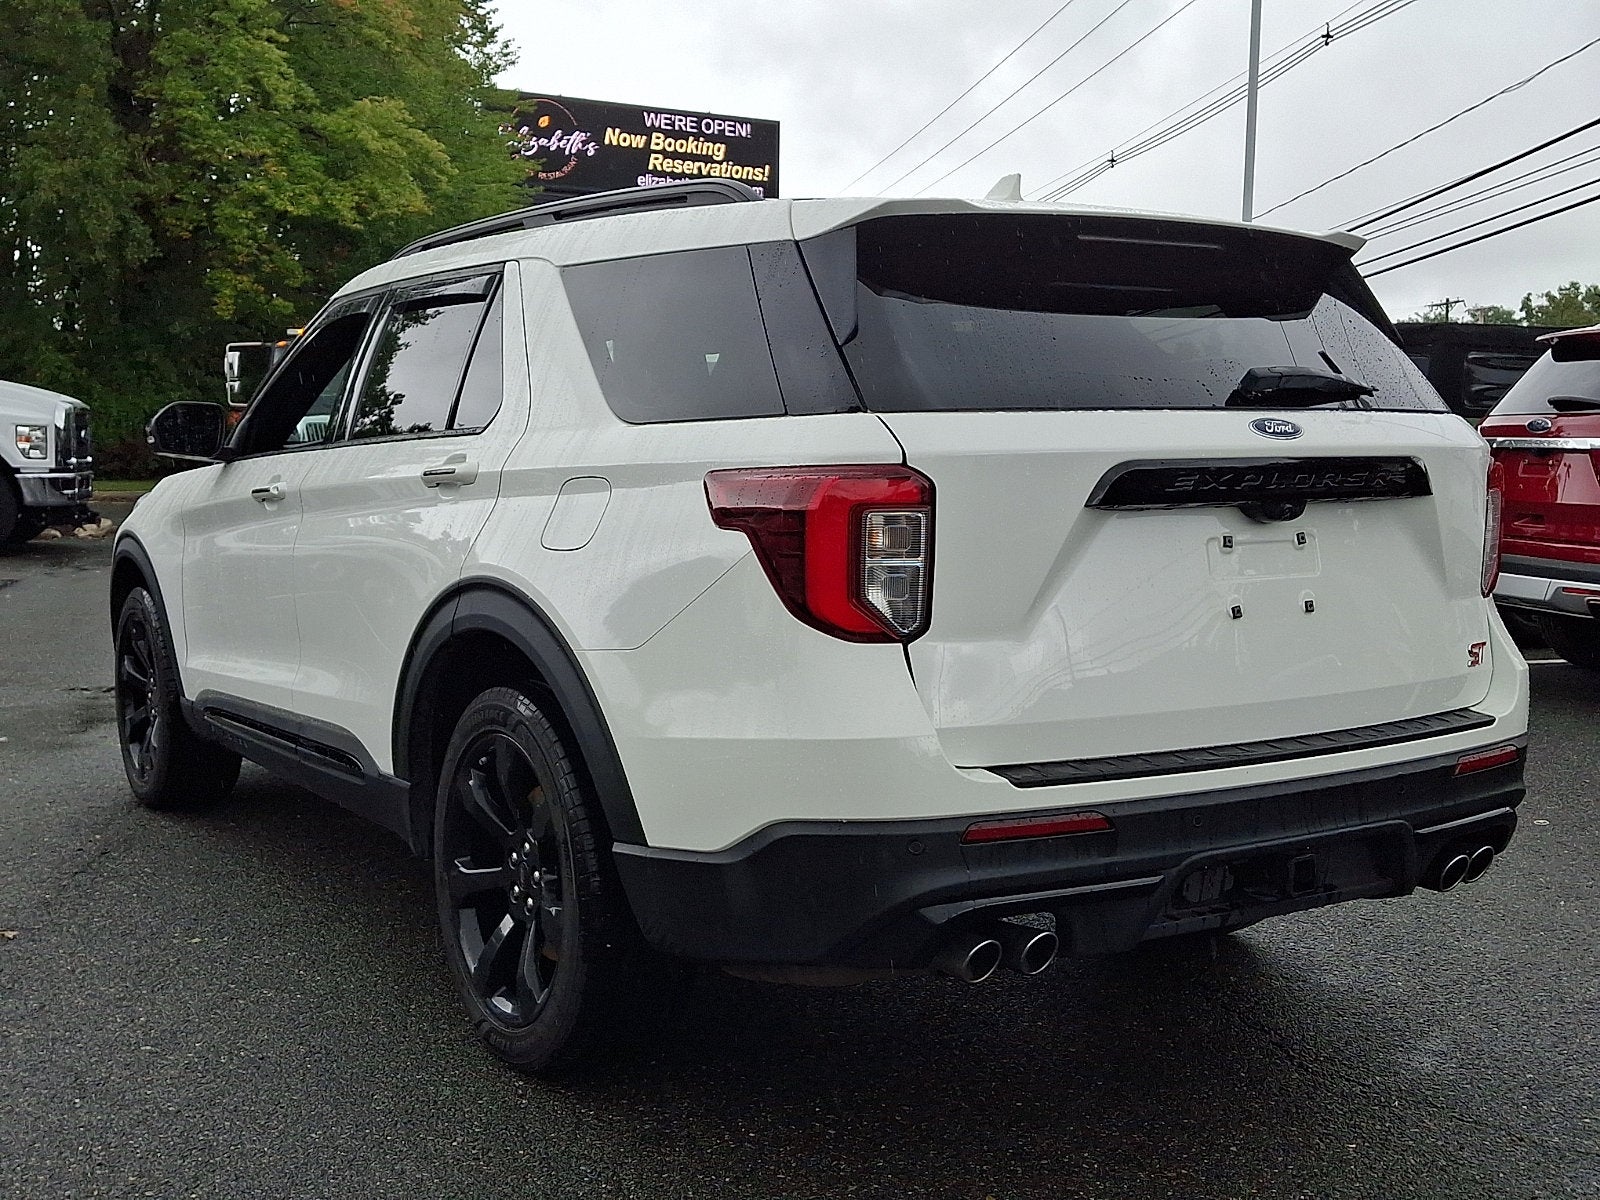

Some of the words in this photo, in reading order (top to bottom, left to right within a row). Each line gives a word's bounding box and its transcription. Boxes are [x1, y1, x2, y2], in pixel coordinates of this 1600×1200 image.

[642, 111, 698, 133] WE'RE
[701, 118, 752, 139] OPEN!
[604, 127, 647, 149] Now
[650, 132, 726, 161] Booking
[648, 153, 771, 182] Reservations!
[1264, 420, 1295, 433] Ford
[1165, 470, 1400, 491] EXPLORER
[1467, 641, 1487, 667] ST
